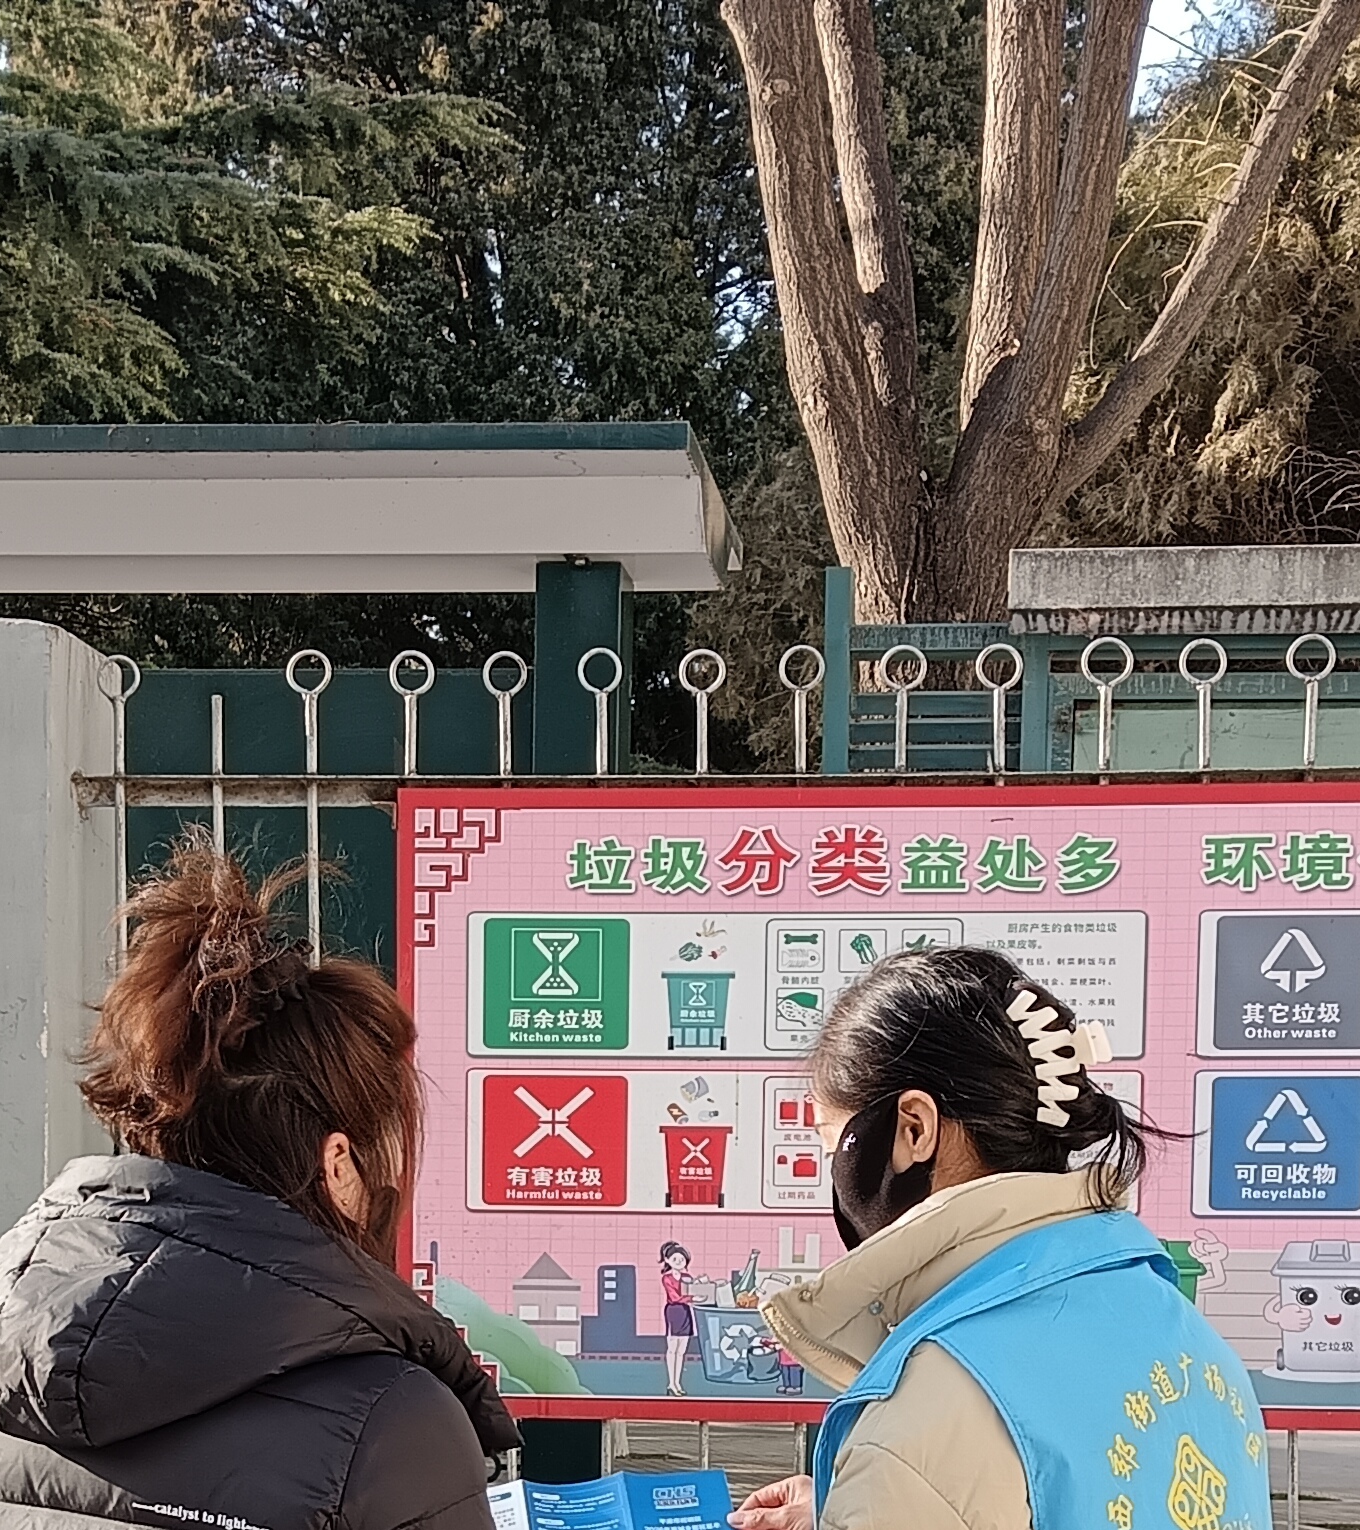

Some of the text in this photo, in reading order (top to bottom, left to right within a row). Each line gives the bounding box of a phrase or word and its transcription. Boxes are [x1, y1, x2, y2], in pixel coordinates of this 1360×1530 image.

[568, 826, 1120, 895] 垃圾分类益处多
[1007, 922, 1117, 934] 厨房产生的食物类垃圾
[508, 1008, 604, 1029] 厨余垃圾
[1242, 1003, 1341, 1024] 其它垃圾
[509, 1032, 602, 1043] Kitchen waste
[1244, 1027, 1337, 1039] Other waste
[507, 1166, 602, 1187] 有害垃圾
[1234, 1163, 1337, 1185] 可回收物
[506, 1188, 602, 1200] Harmful waste
[1241, 1188, 1327, 1201] Recyclable
[1301, 1340, 1354, 1353] 其它垃圾
[154, 1504, 199, 1521] catalyst
[202, 1511, 215, 1524] to
[217, 1513, 246, 1530] light
